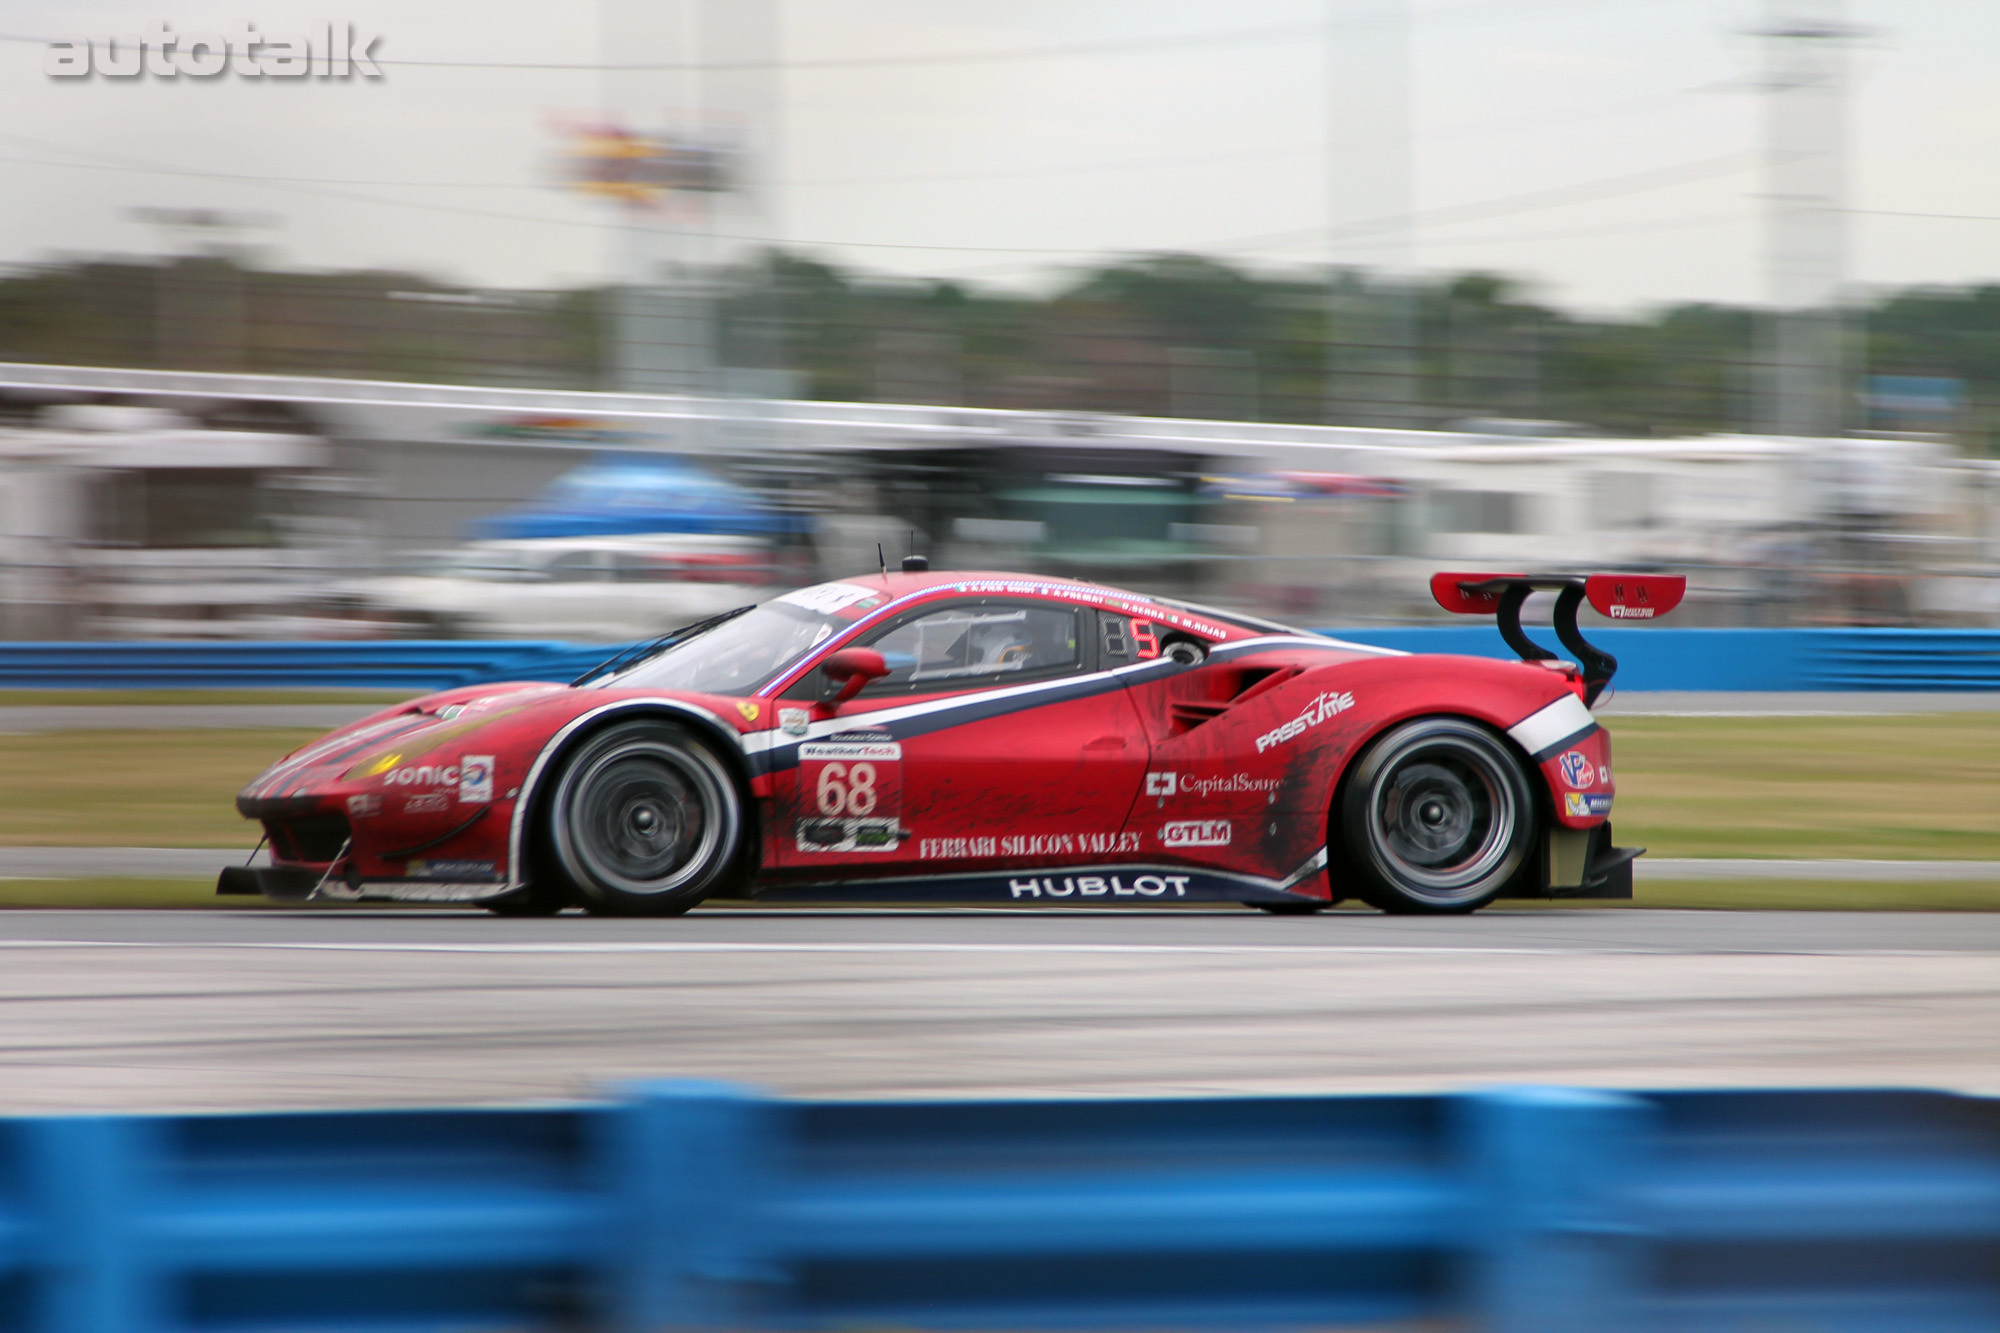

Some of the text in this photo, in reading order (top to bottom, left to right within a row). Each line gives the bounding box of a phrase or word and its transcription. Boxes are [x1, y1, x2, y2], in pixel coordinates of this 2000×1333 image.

[804, 745, 896, 756] WeatherTech
[1559, 751, 1586, 787] VP
[816, 761, 877, 818] 68
[919, 830, 1142, 859] FERRARI SILICON VALLEY
[1167, 823, 1229, 843] GTLM
[1009, 875, 1190, 898] HUBLOT
